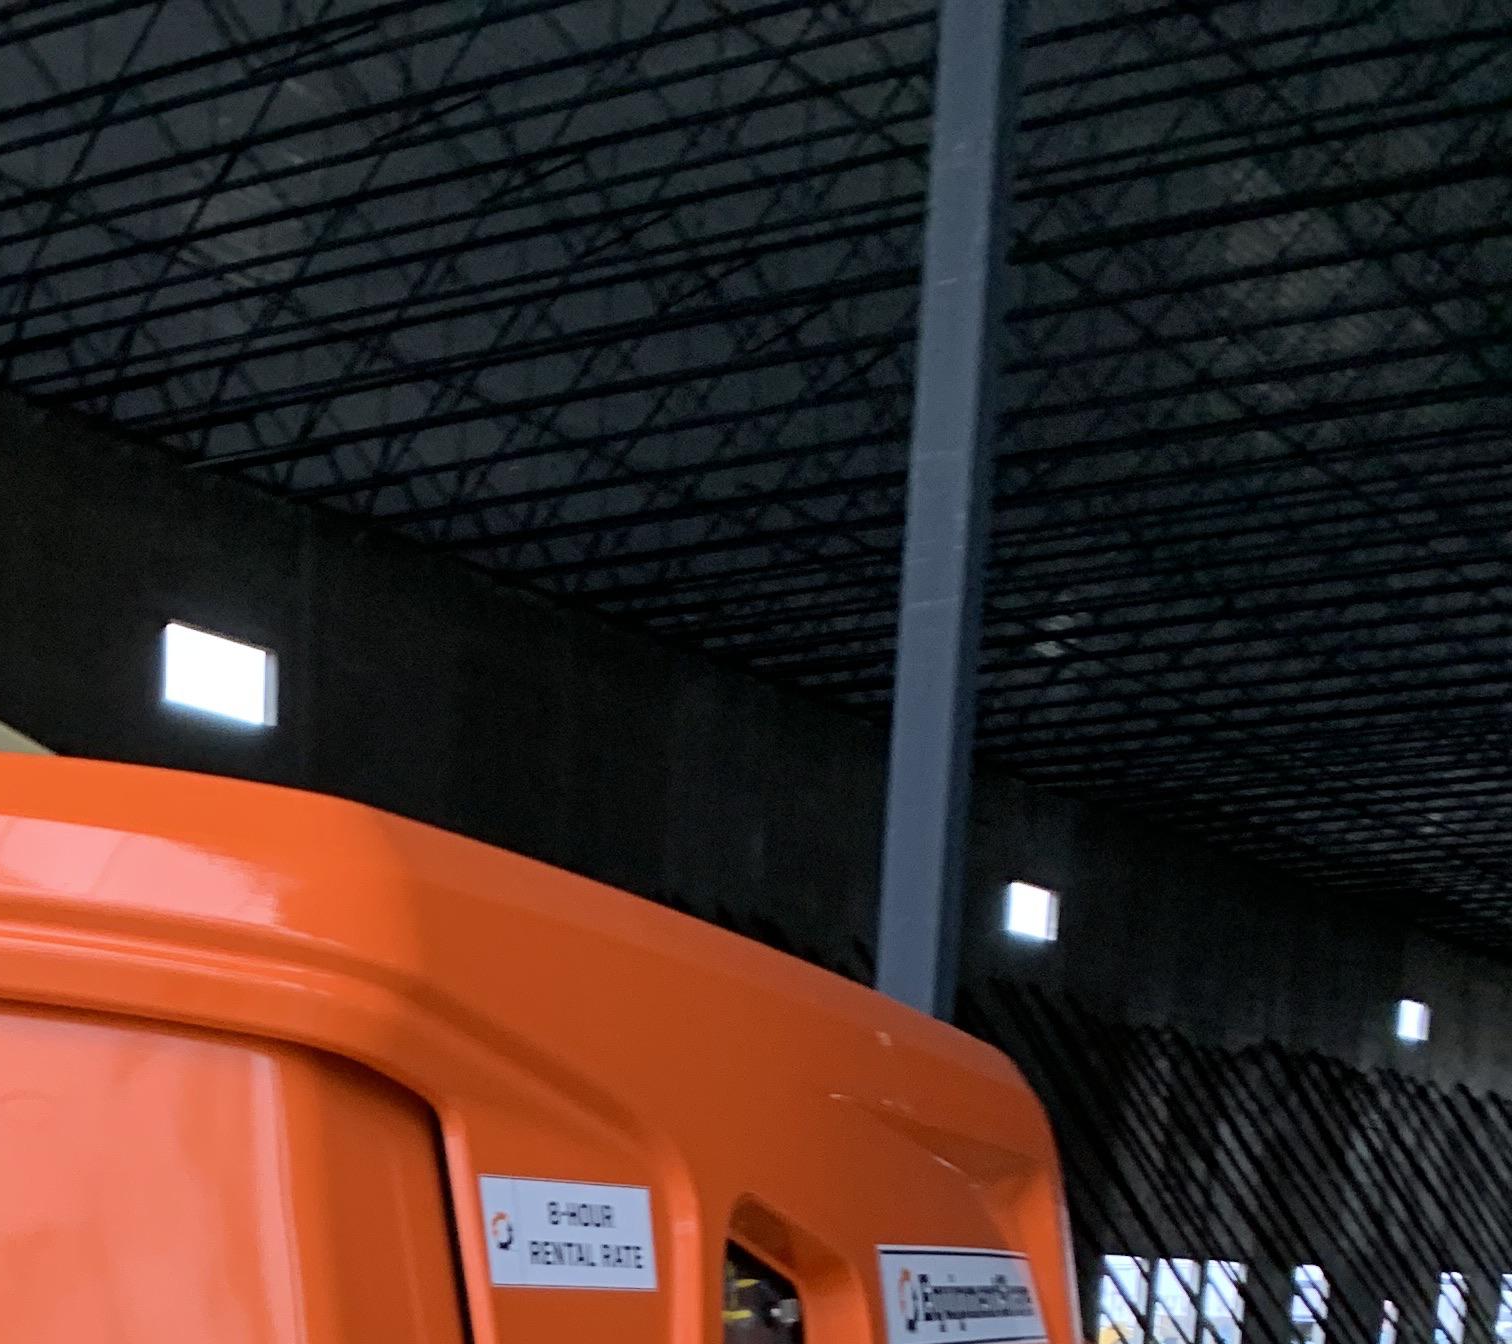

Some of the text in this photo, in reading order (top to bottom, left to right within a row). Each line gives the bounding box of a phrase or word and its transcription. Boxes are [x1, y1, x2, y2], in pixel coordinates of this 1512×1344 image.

[548, 1200, 616, 1229] 8-HOUR
[528, 1239, 644, 1269] RENTAL RATE
